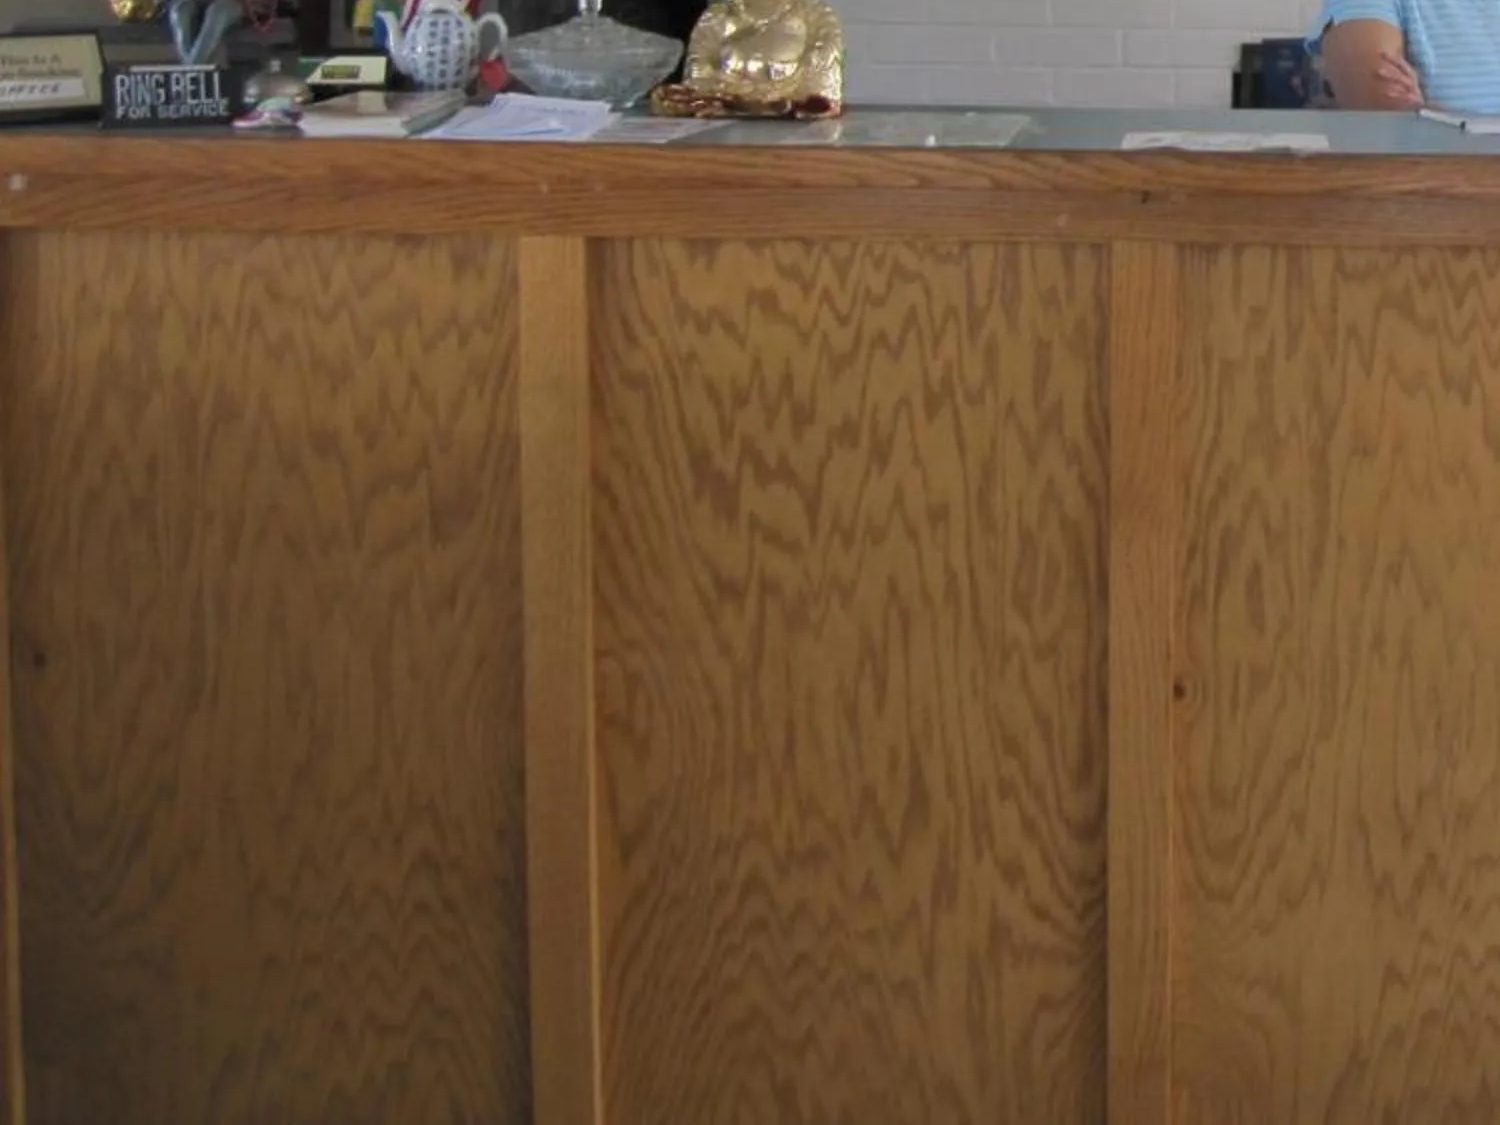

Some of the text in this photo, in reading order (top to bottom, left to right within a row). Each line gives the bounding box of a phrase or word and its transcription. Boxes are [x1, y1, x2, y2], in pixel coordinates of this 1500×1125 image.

[115, 71, 220, 106] RING BELL
[115, 98, 231, 119] FOR SERVICE
